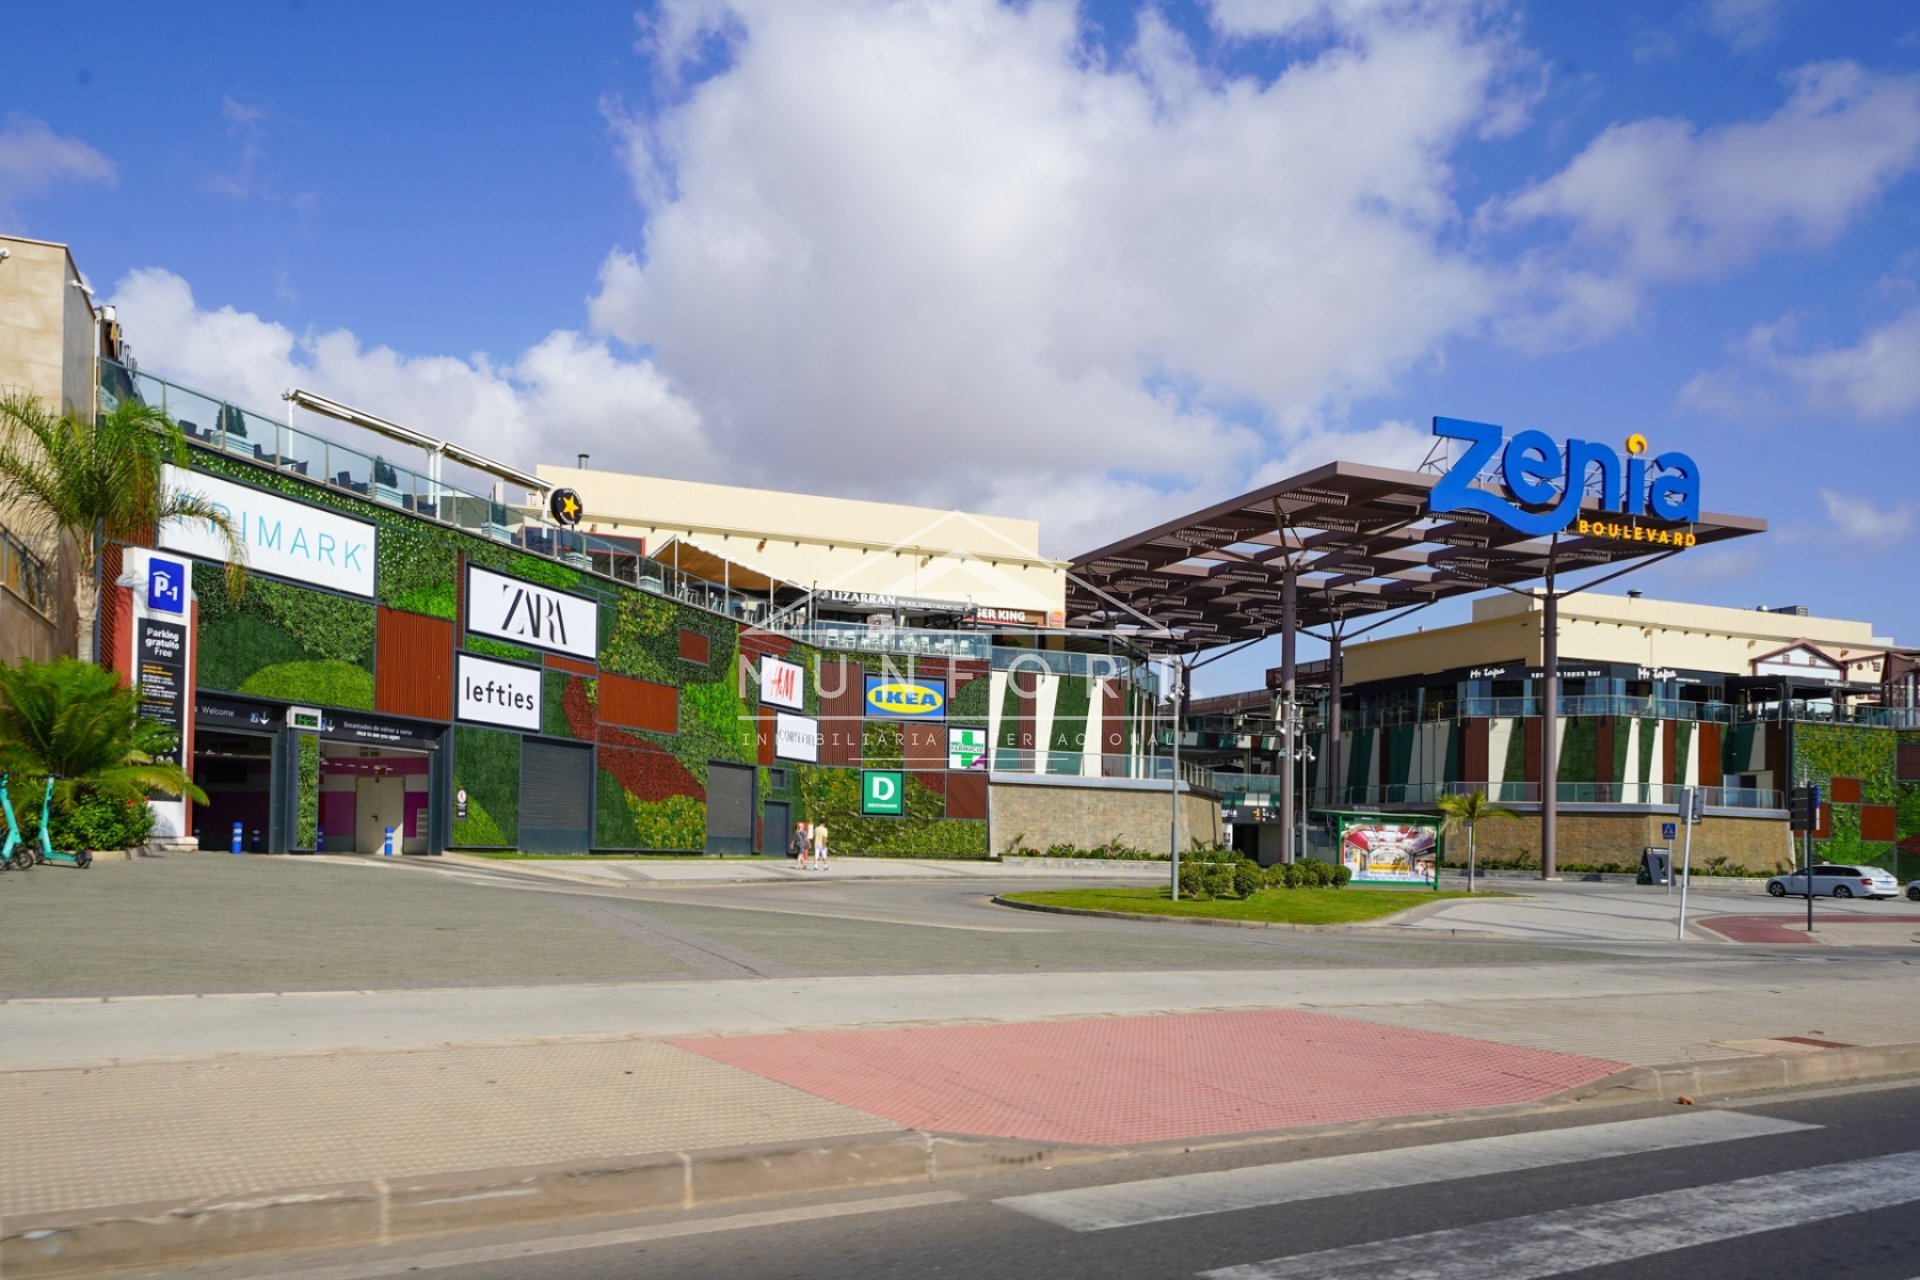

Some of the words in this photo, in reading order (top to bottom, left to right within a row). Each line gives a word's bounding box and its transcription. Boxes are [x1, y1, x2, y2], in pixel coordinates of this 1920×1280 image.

[1428, 416, 1700, 536] Zenia
[1579, 519, 1696, 547] BOULEVARD
[501, 584, 567, 645] ZARA
[998, 610, 1025, 622] KING
[147, 627, 179, 642] Parking
[155, 646, 173, 658] Free
[466, 676, 534, 710] lefties
[874, 690, 937, 707] IKEA
[201, 706, 234, 717] Welcome
[872, 776, 895, 800] D
